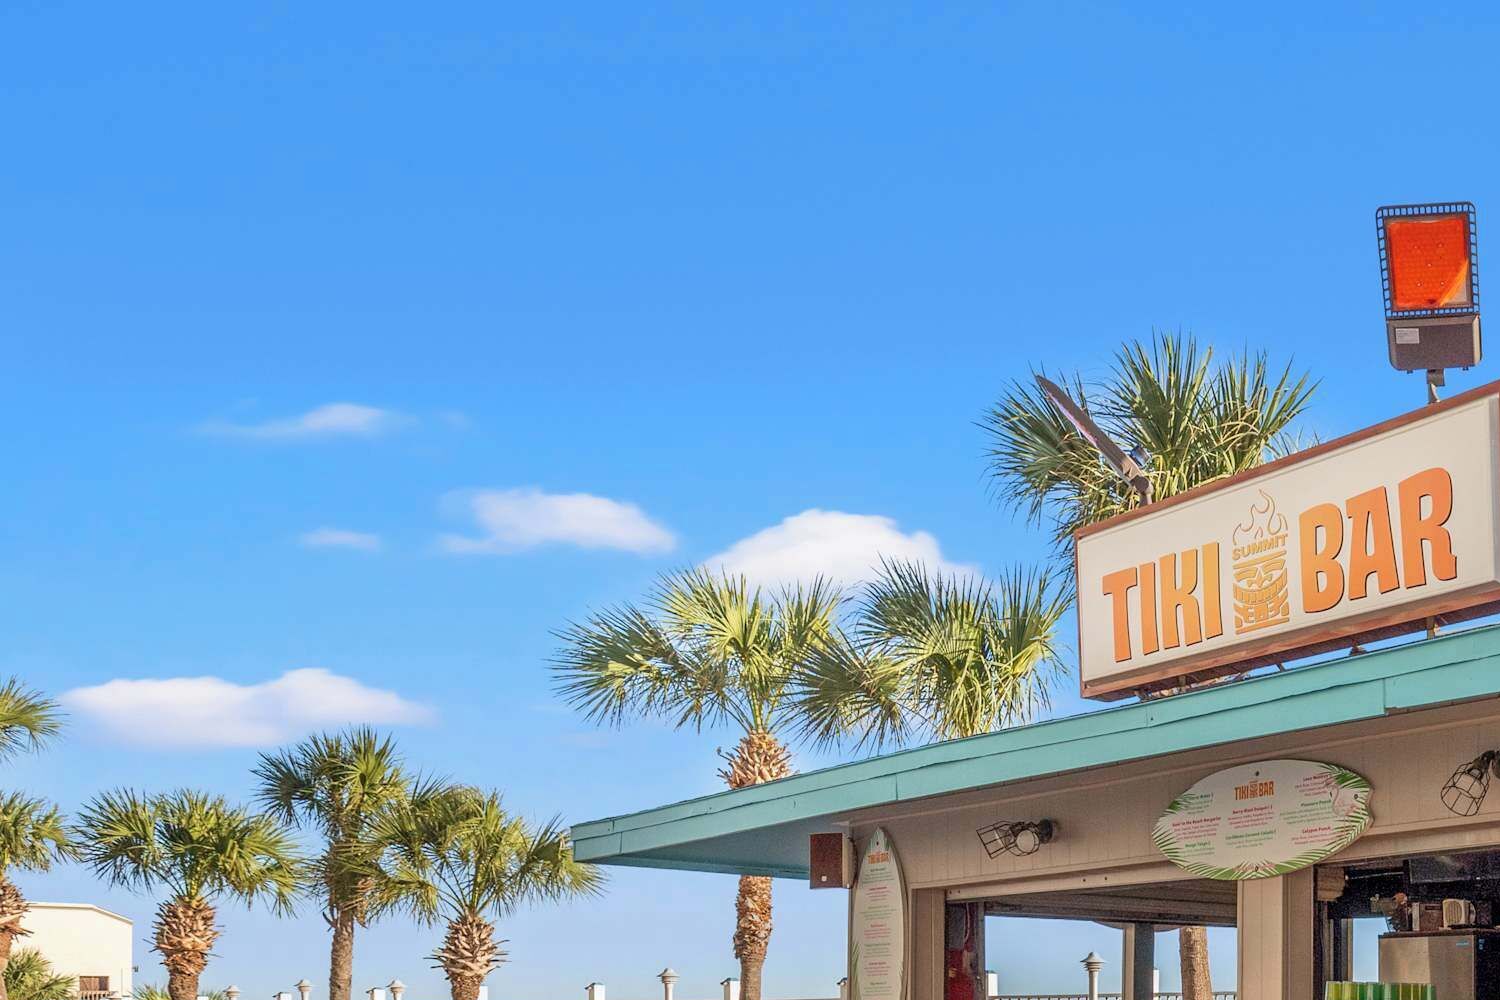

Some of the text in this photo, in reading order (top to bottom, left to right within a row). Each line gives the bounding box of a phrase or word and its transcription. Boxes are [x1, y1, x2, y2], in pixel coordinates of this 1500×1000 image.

[1232, 534, 1287, 560] SUMMIT
[1102, 467, 1457, 663] TIKI BAR
[1235, 781, 1274, 800] TIKI BAR
